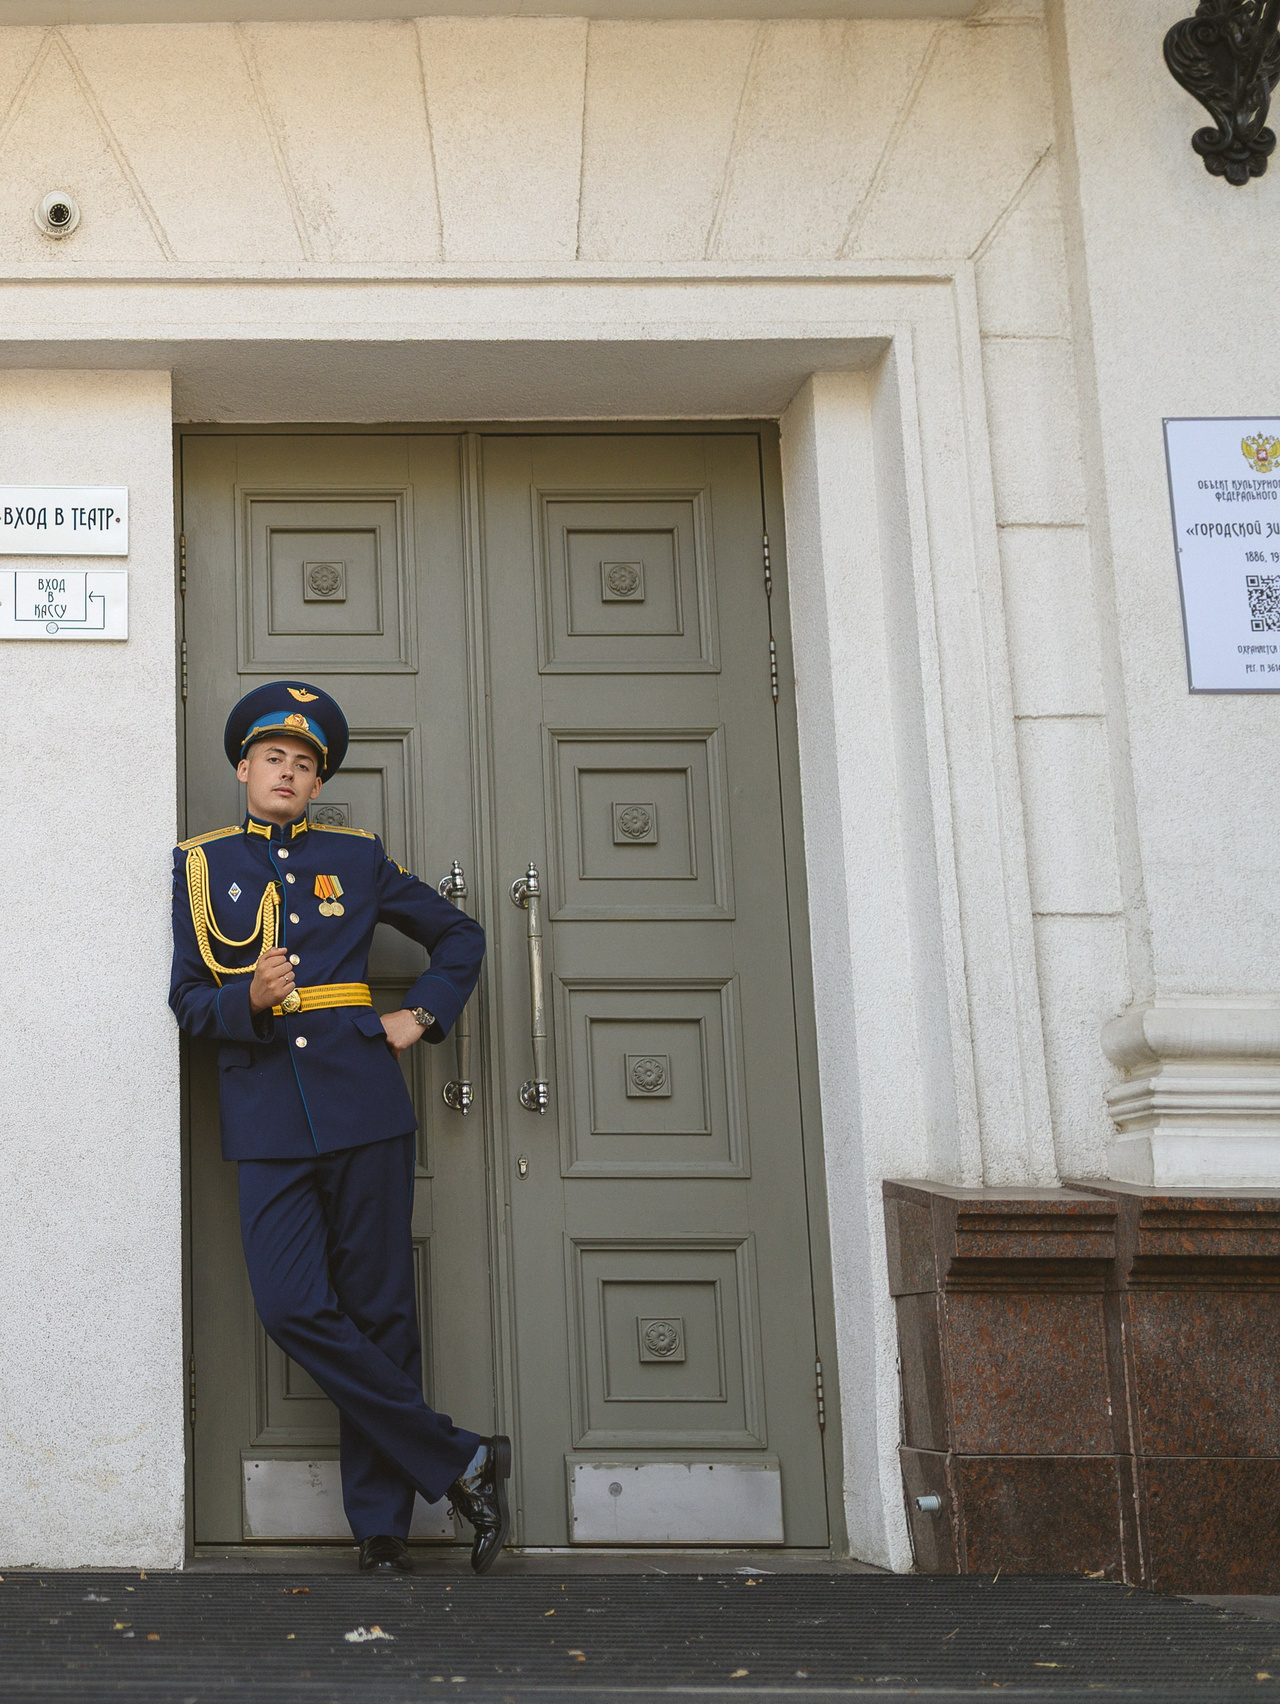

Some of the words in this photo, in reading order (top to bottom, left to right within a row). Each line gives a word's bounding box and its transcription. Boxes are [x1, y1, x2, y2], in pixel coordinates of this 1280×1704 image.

[1197, 480, 1228, 491] ОБЪЕКТ
[1215, 491, 1278, 502] ФЕДЕРАЛЬНОГО
[4, 507, 47, 529] ВХОД
[55, 507, 64, 525] В
[71, 508, 114, 530] ТЕАТР
[1186, 520, 1262, 538] «ГОРОДСКОЙ
[38, 578, 66, 593] ВХОД
[48, 591, 54, 603] В
[34, 604, 67, 619] КАССУ
